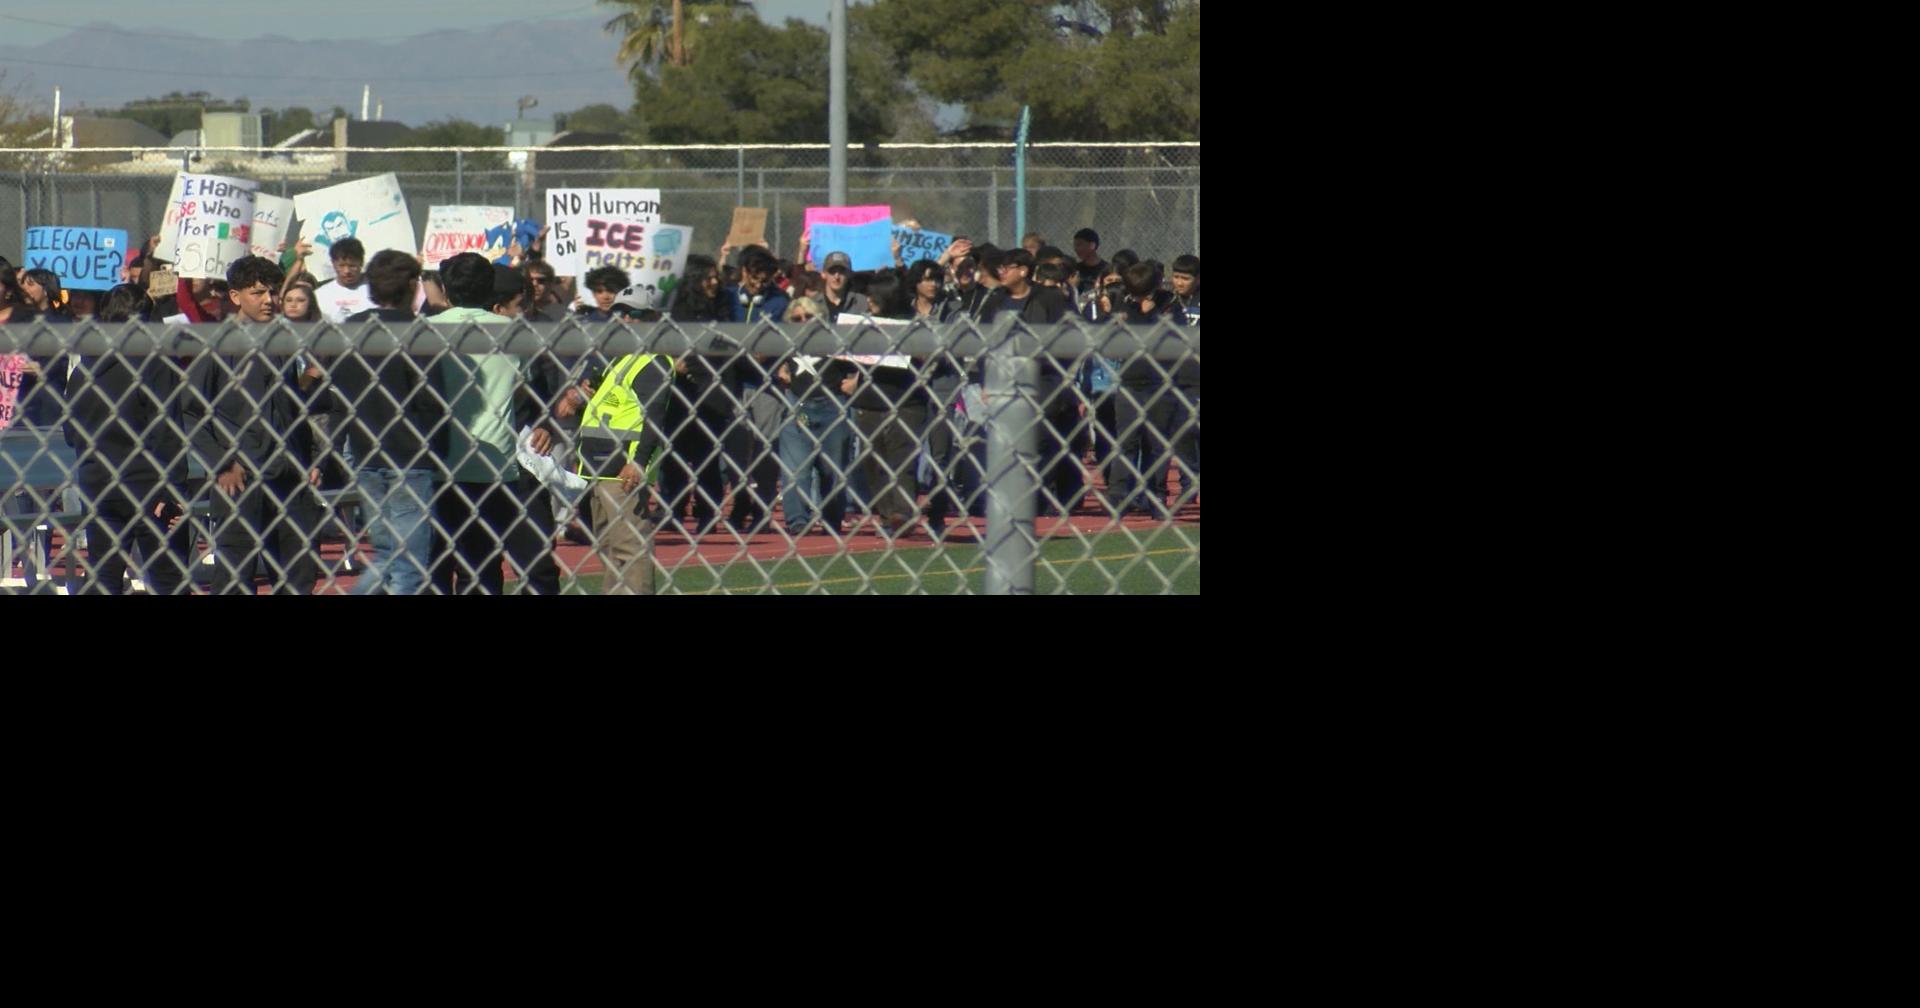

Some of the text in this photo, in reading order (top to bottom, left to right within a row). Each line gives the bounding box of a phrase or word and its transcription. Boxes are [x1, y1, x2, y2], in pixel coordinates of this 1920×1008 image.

[552, 192, 660, 216] NO Human
[27, 229, 104, 251] ILEGAL
[555, 221, 570, 239] IS
[586, 219, 645, 251] ICE
[652, 255, 672, 271] in
